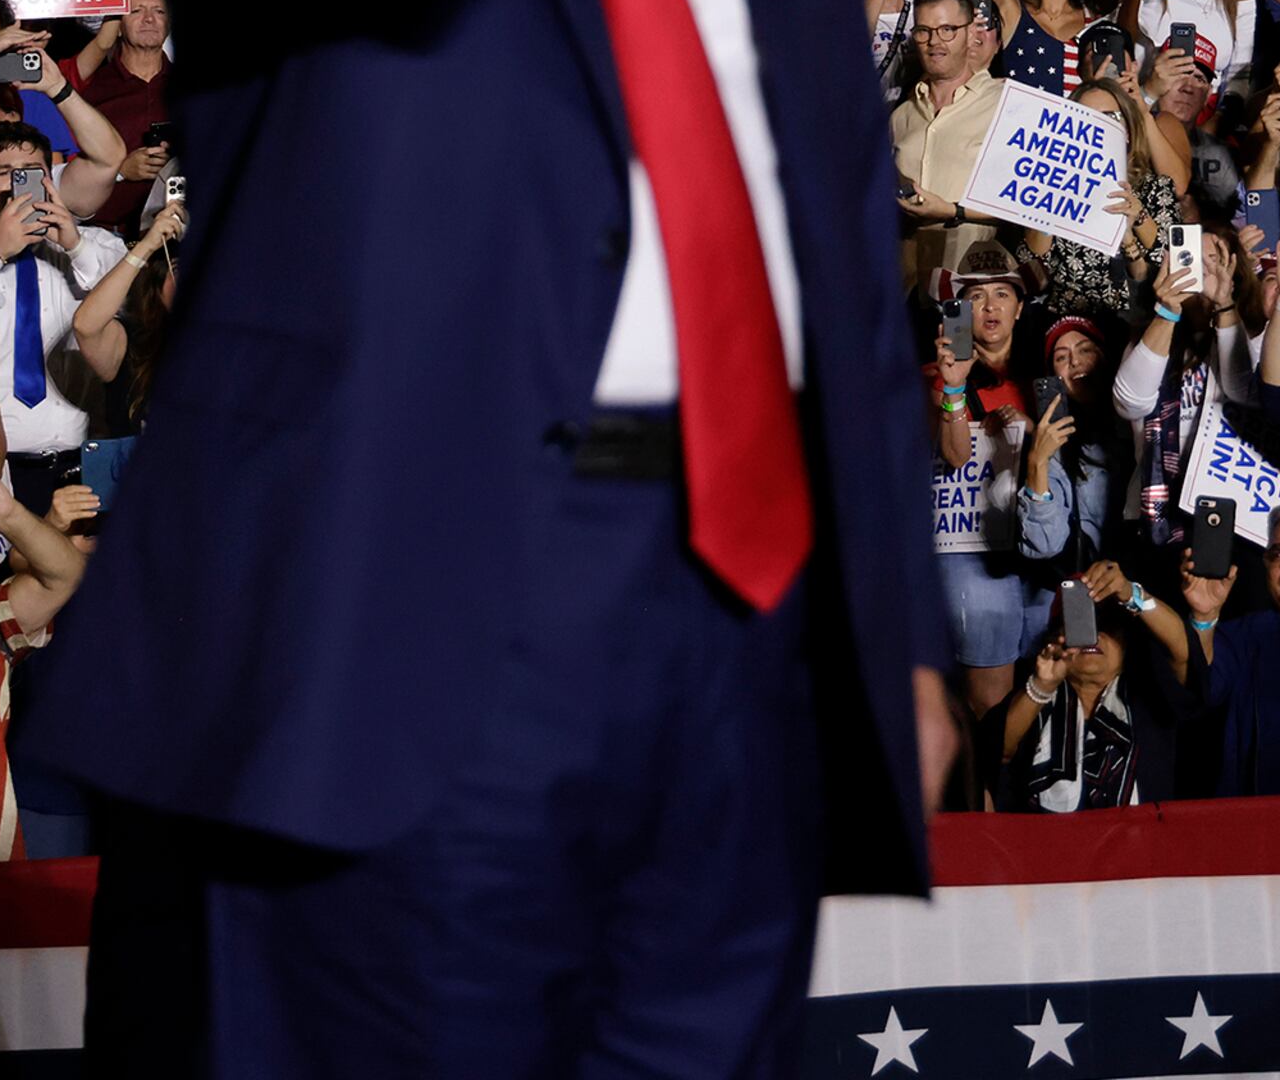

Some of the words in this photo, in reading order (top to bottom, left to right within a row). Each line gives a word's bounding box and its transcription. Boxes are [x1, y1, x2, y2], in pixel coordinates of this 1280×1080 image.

[1039, 108, 1105, 148] MAKE
[1007, 127, 1118, 180] AMERICA
[999, 179, 1091, 224] AGAIN!
[1014, 156, 1101, 202] GREAT
[934, 461, 994, 482] ERICA
[1207, 418, 1237, 482] AIN!
